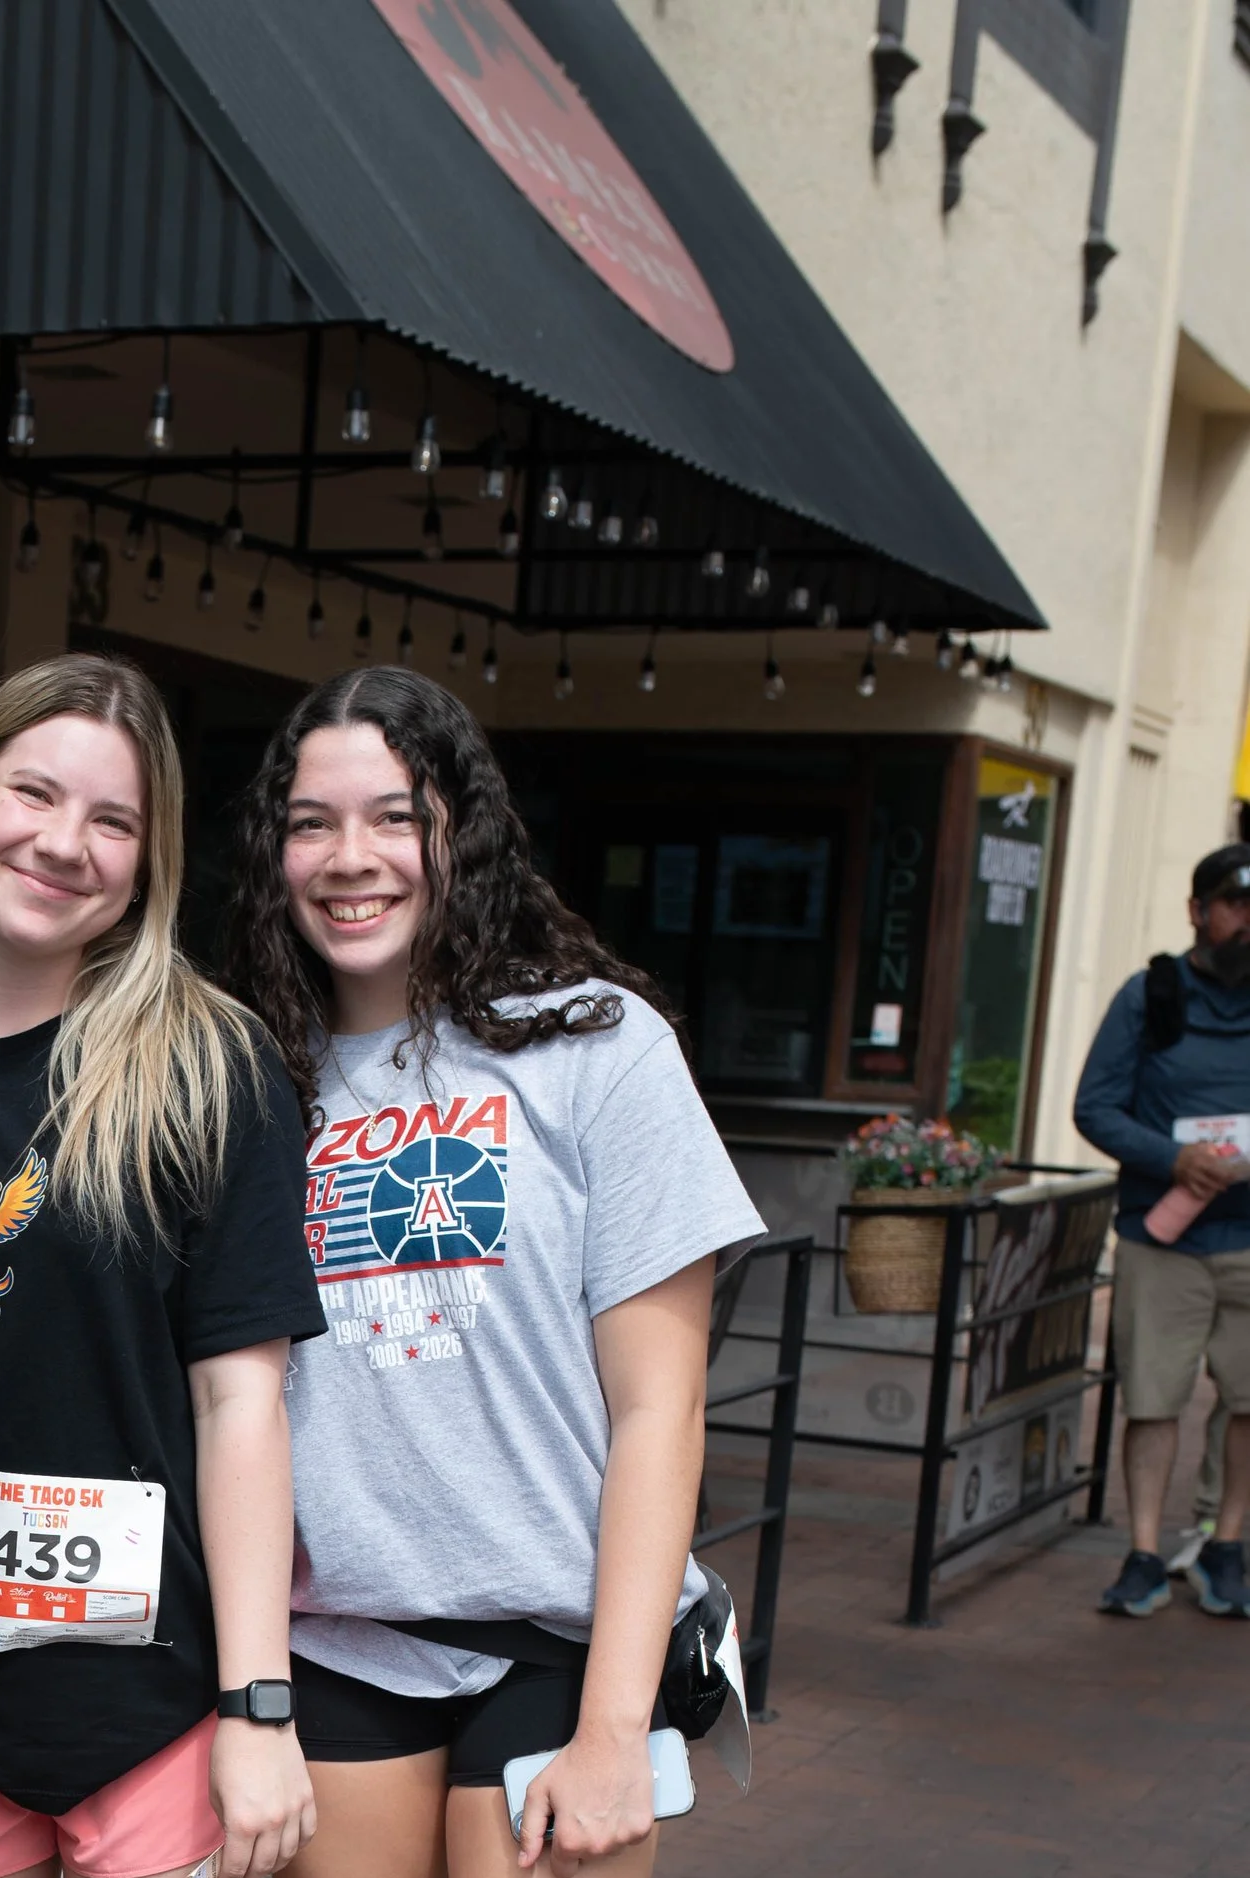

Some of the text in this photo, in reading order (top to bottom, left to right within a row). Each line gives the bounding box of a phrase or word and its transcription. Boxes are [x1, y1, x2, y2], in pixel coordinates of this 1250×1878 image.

[877, 825, 924, 991] OPEN
[319, 1286, 345, 1311] TH
[382, 1309, 426, 1340] 1994
[444, 1304, 478, 1330] 1997
[366, 1332, 463, 1370] 2001 2026
[29, 1485, 77, 1507] TACO
[79, 1488, 104, 1508] 5K
[22, 1511, 68, 1529] TUCSON
